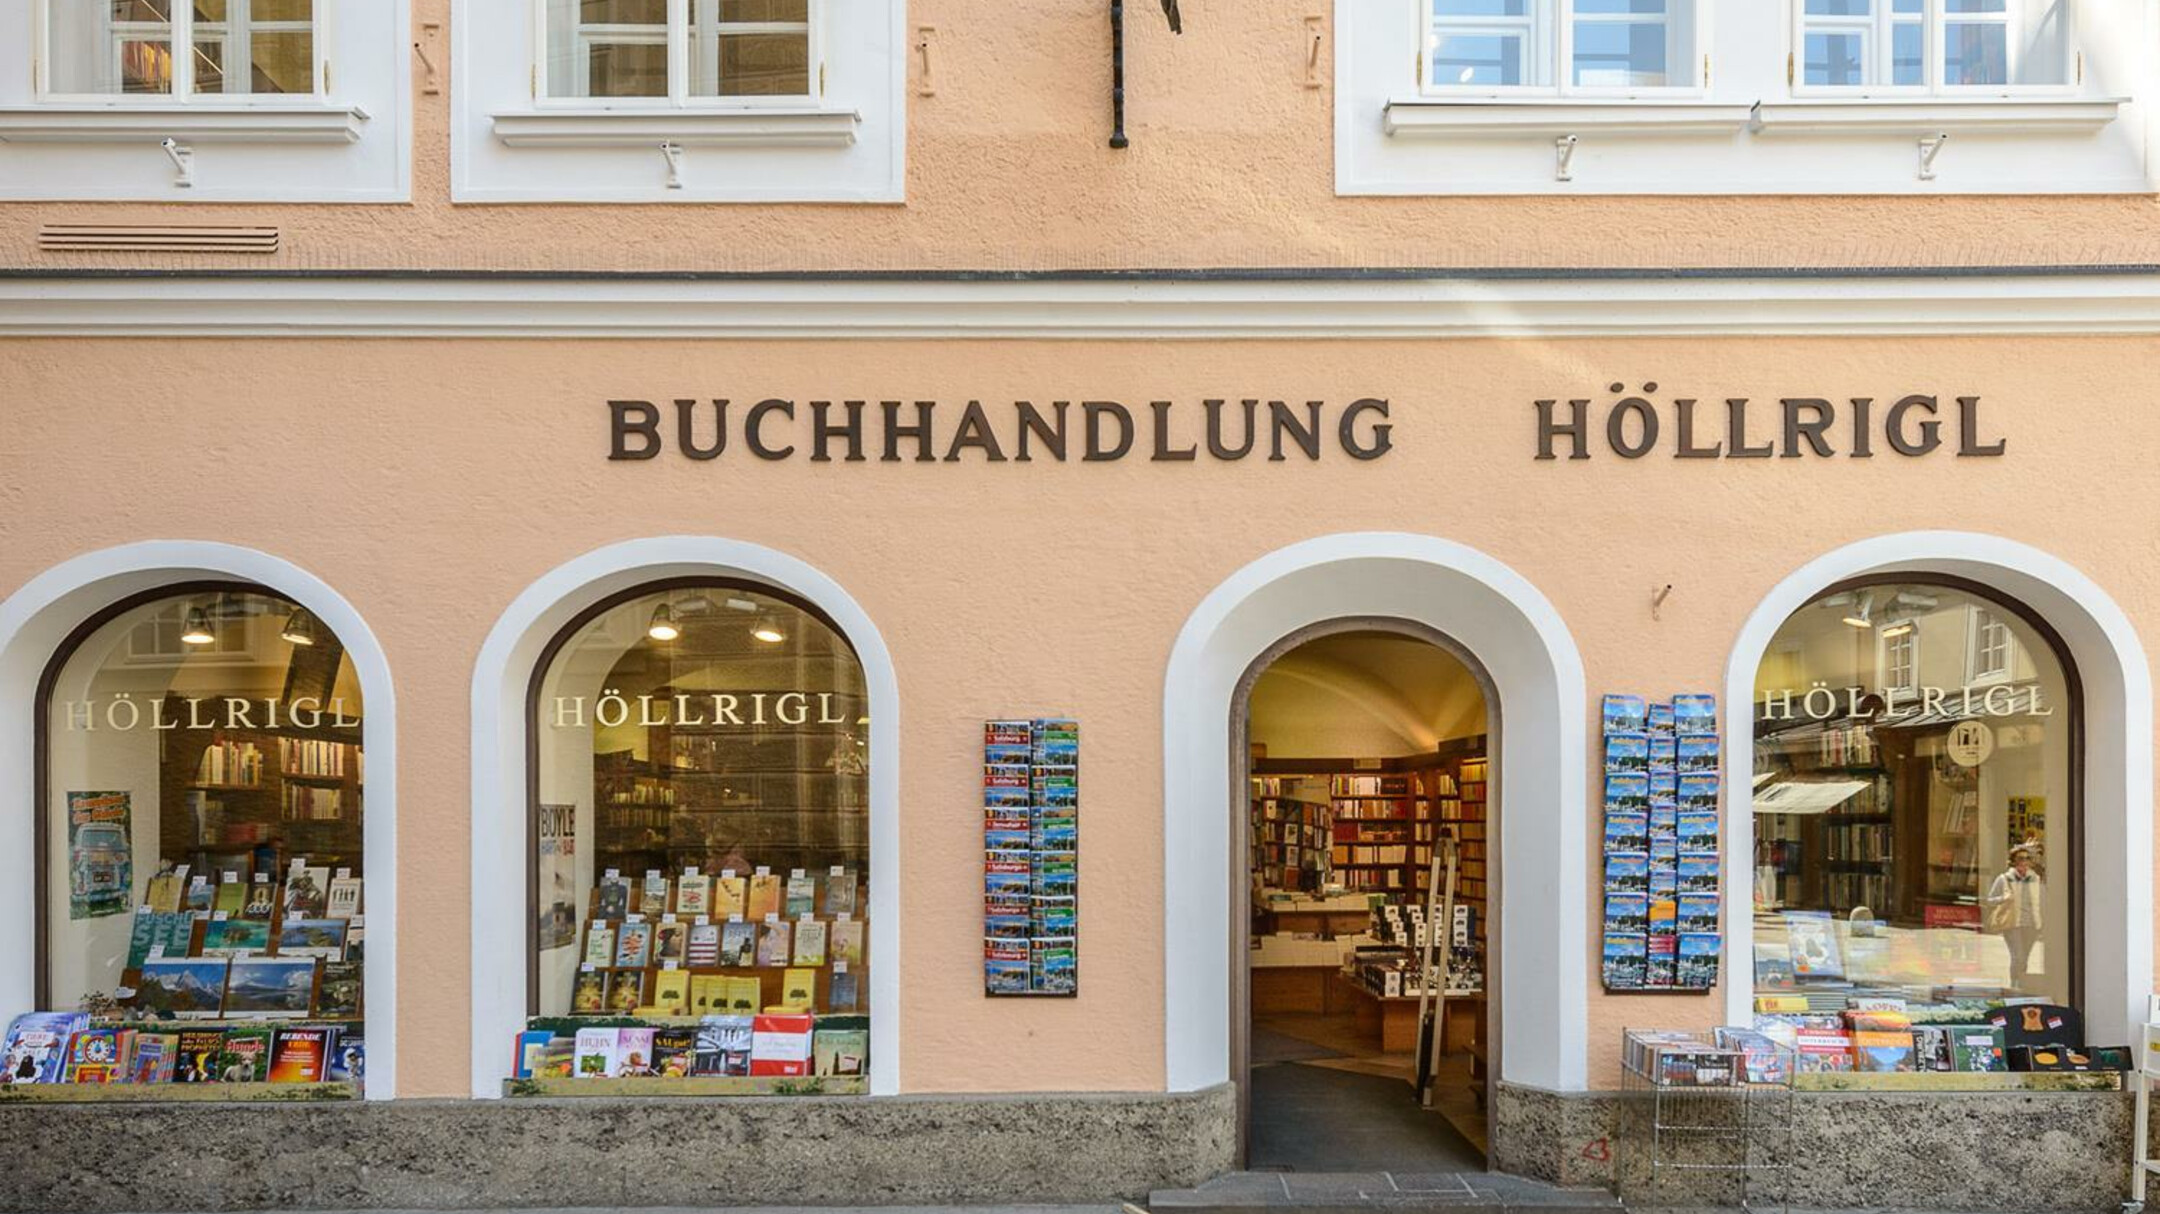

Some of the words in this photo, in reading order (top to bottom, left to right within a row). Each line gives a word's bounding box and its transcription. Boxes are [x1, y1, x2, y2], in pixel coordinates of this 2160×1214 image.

[607, 397, 1393, 462] BUCHHANDLUNG
[1533, 381, 2006, 460] HÖLLRIGL
[66, 693, 360, 731] HÖLLRIGL
[555, 689, 846, 727] HÖLLRIGL
[1761, 681, 2053, 720] HÖLLRIGL
[541, 808, 575, 837] BOYLE
[134, 925, 191, 945] SEE
